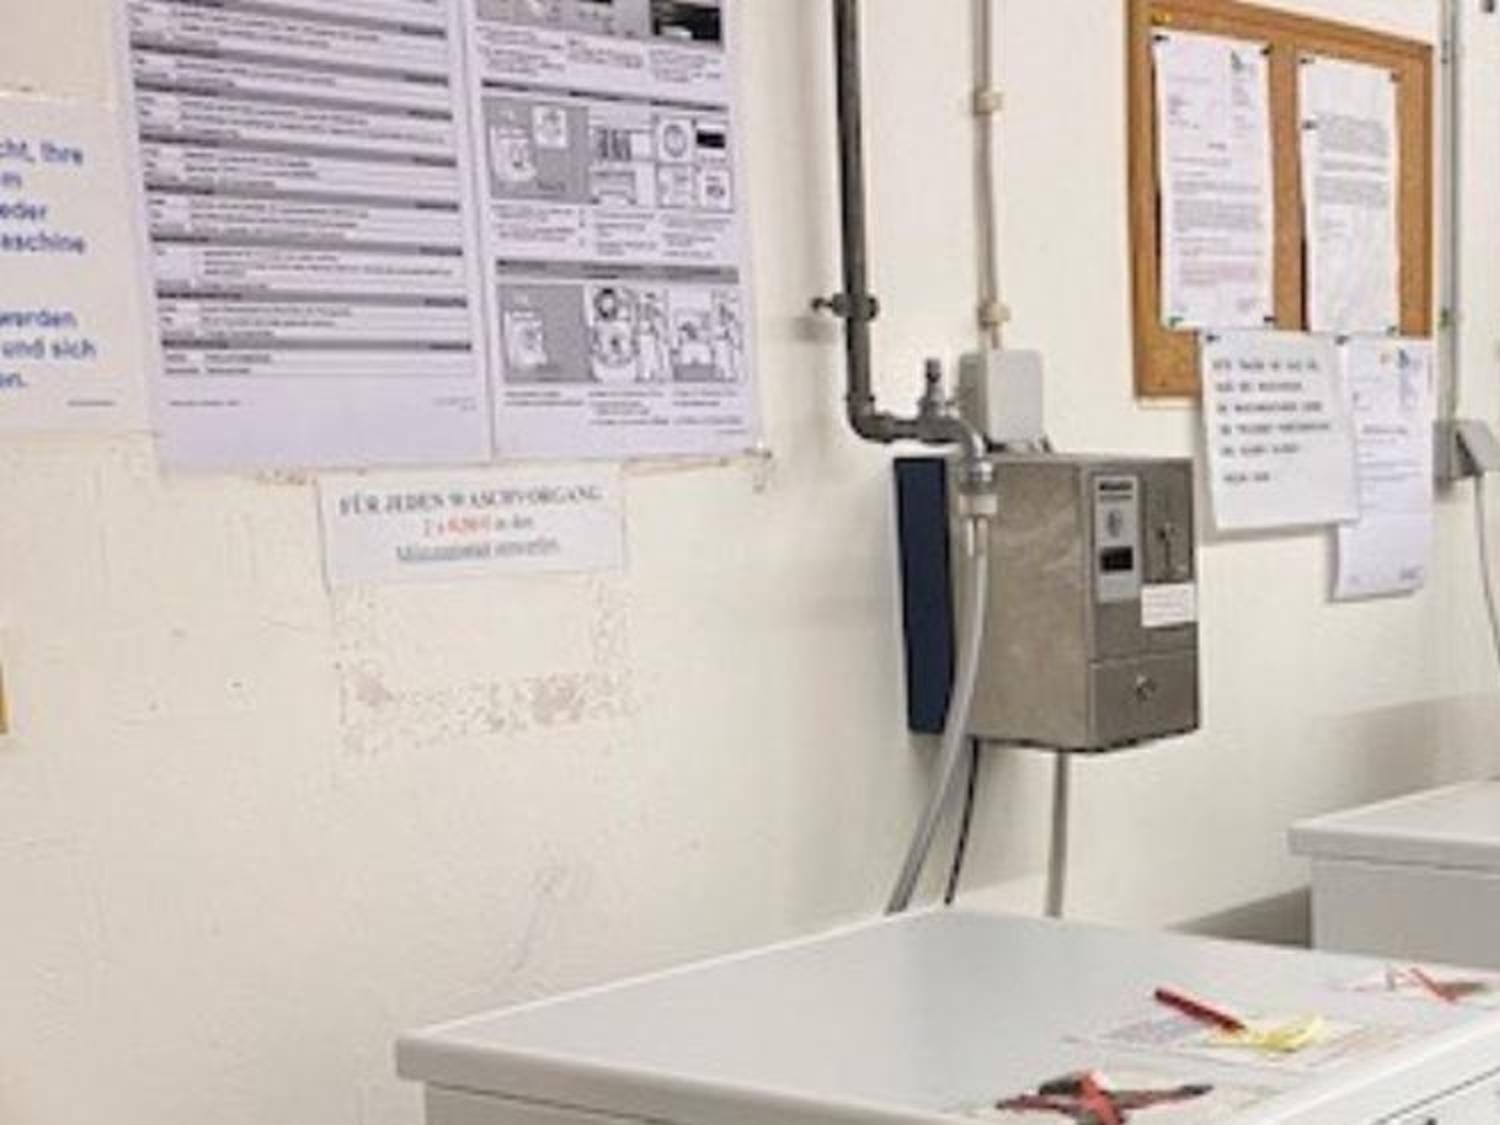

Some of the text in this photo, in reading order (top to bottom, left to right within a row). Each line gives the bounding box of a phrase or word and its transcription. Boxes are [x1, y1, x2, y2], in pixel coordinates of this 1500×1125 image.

[41, 142, 84, 166] Ihre
[2, 338, 97, 360] und sich
[385, 492, 445, 513] JEDEN
